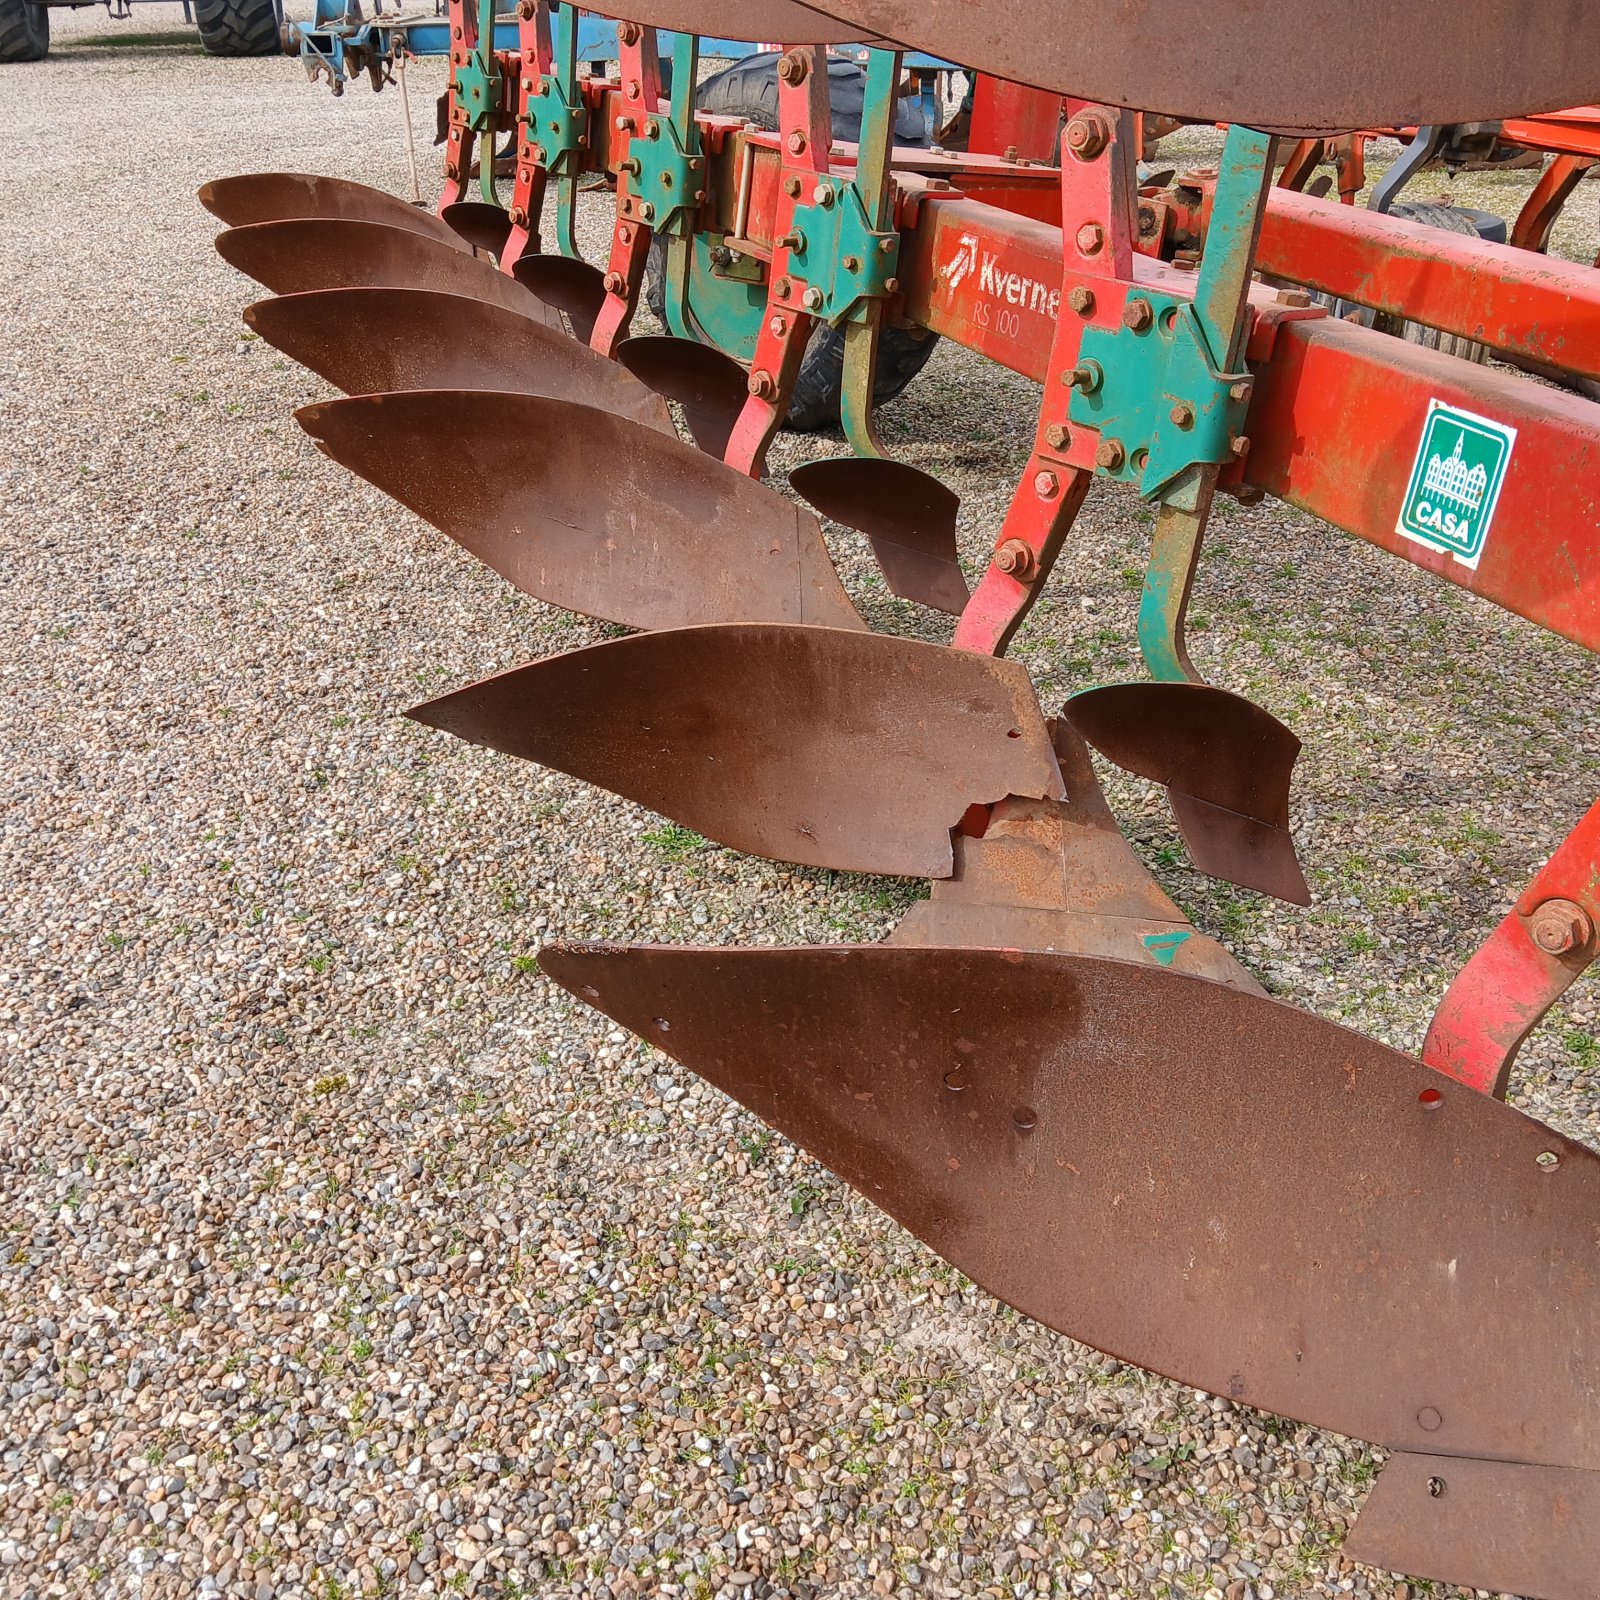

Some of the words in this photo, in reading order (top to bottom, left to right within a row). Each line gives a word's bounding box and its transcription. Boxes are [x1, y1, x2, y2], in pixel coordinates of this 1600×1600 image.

[973, 300, 992, 327] RS
[995, 309, 1020, 338] 100
[1415, 501, 1469, 543] CASA
